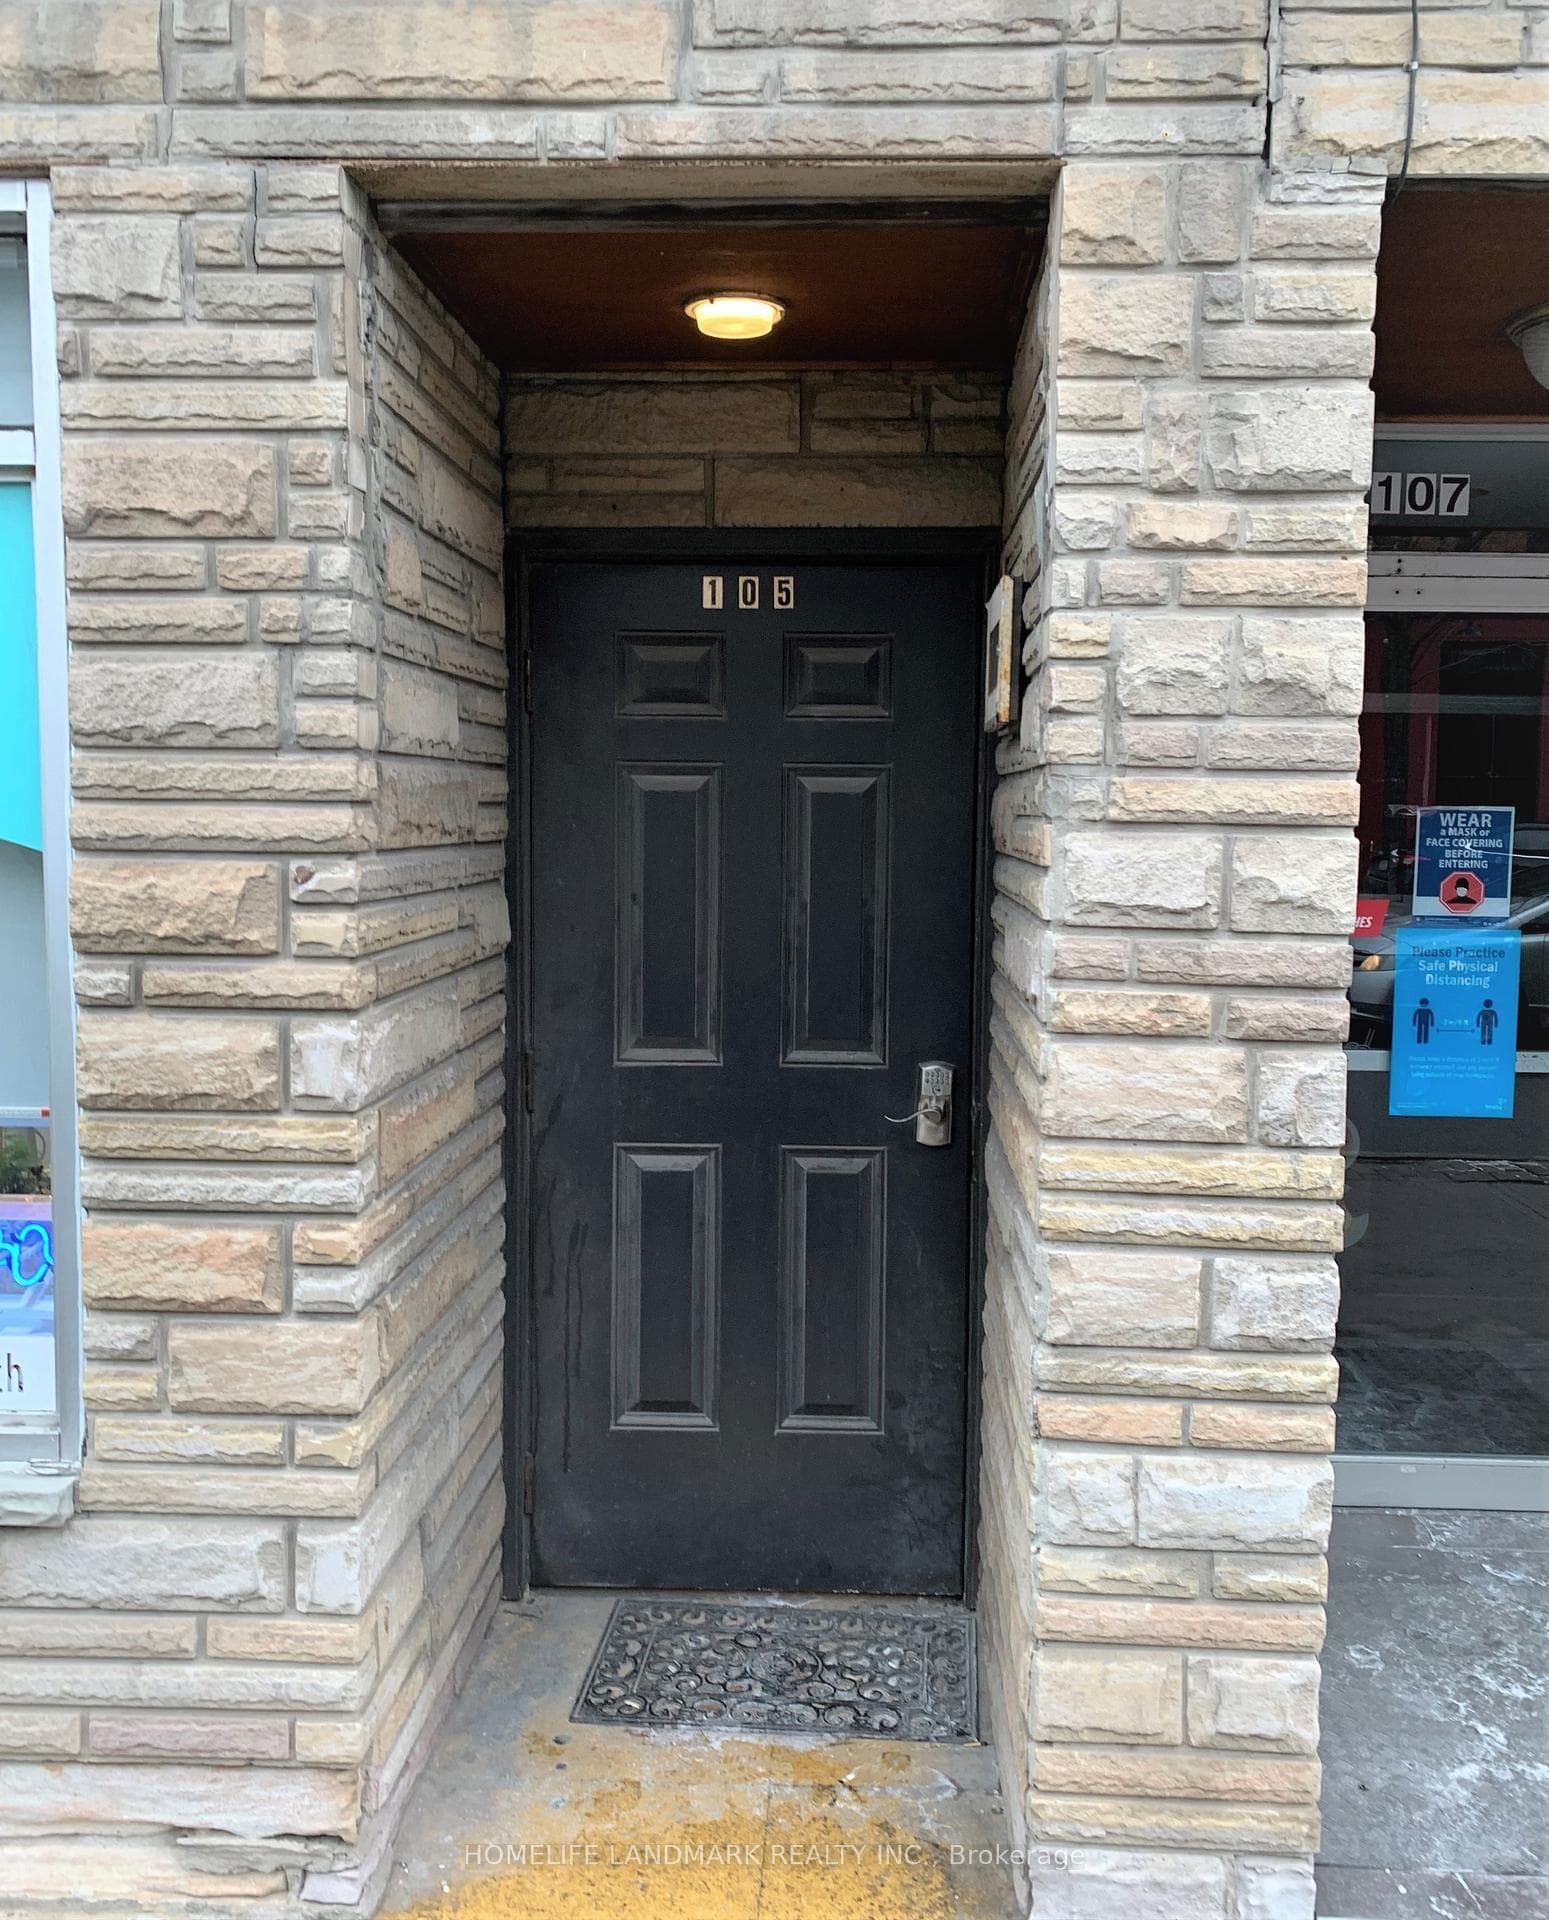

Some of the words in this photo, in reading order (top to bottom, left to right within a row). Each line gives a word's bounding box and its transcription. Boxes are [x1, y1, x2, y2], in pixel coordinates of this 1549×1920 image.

[1378, 475, 1469, 513] 107
[708, 579, 791, 606] 105
[1440, 813, 1492, 827] WEAR
[1448, 828, 1477, 836] MASK
[1426, 838, 1450, 847] FACE
[1452, 839, 1503, 848] COVERING
[1445, 850, 1483, 858] BEFORE
[1439, 860, 1488, 869] ENTERING
[1412, 945, 1452, 957] Please
[1456, 947, 1505, 958] Practice
[1419, 960, 1445, 971] Safe
[1449, 960, 1498, 974] Physical
[1425, 974, 1490, 989] Distancing
[0, 1353, 24, 1392] h
